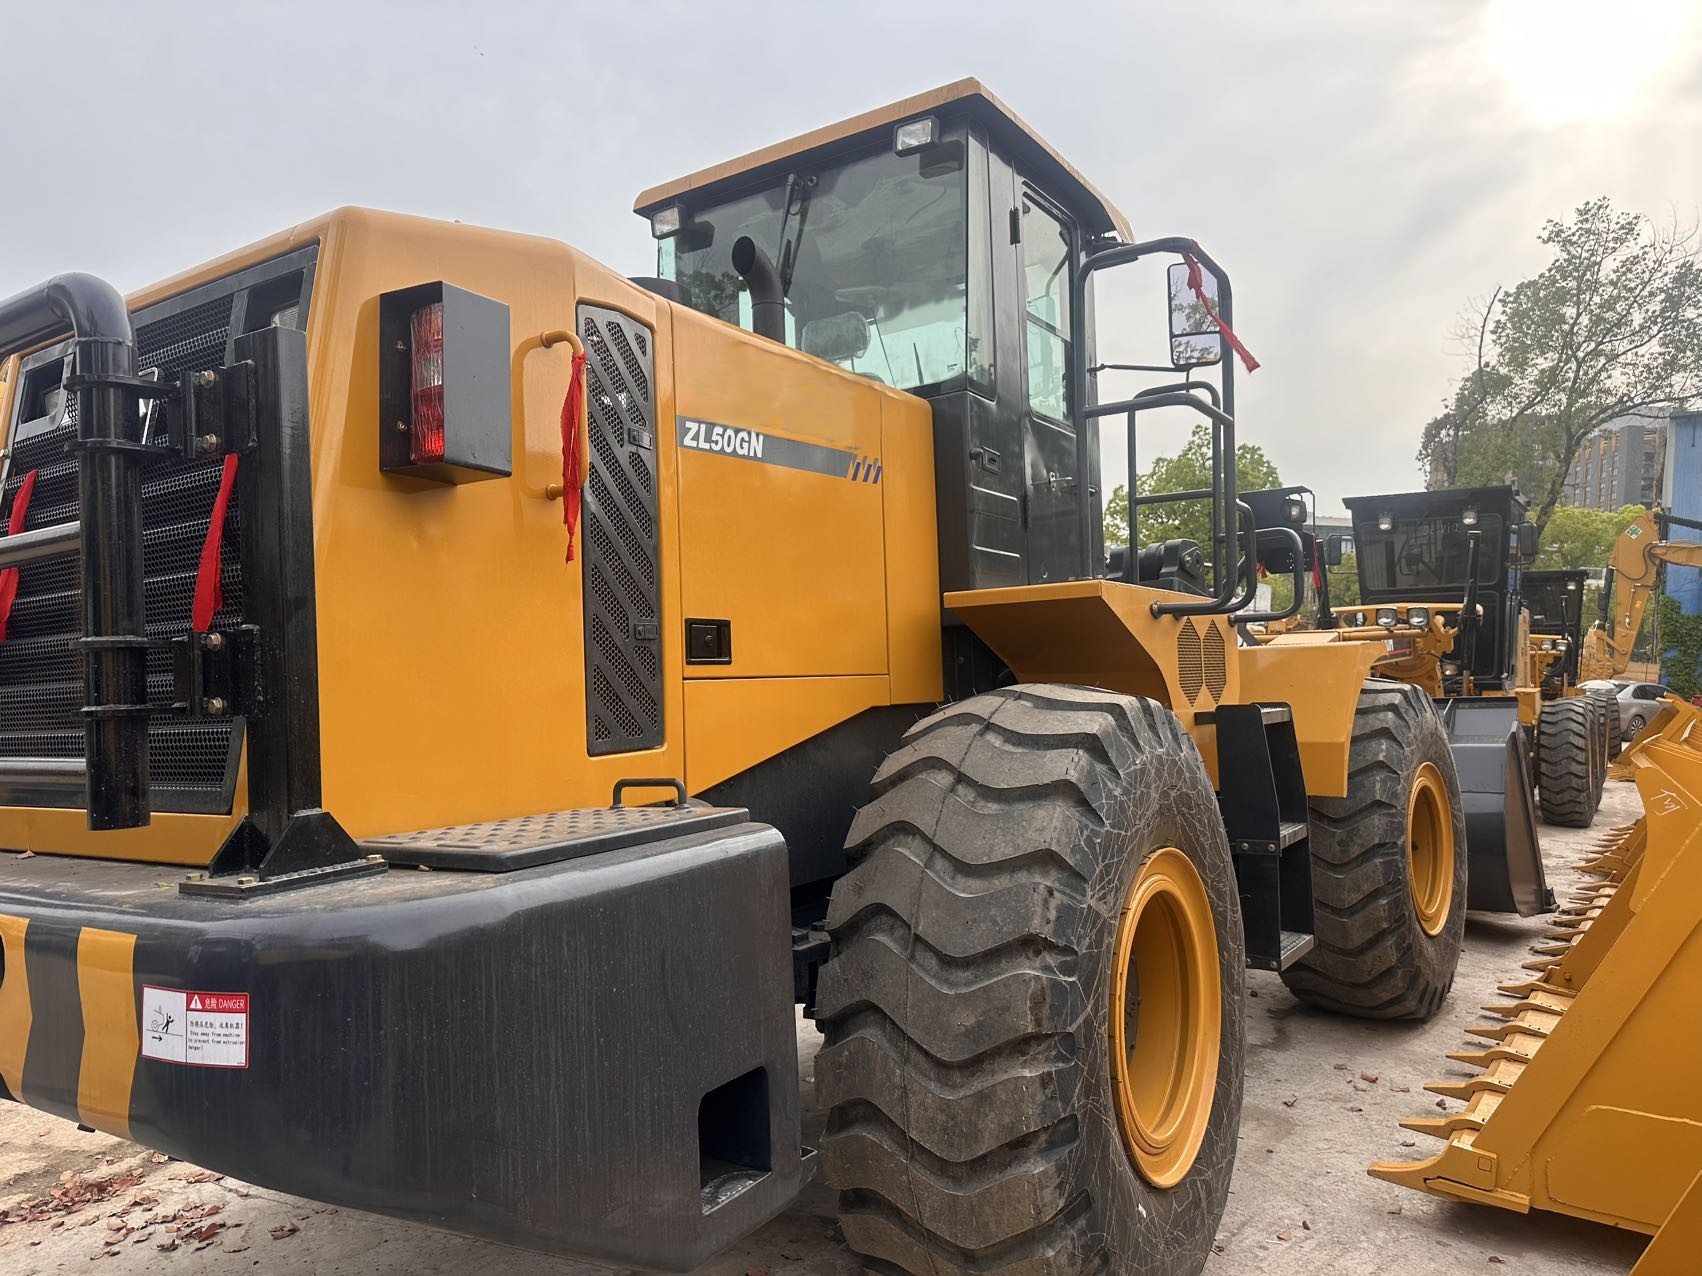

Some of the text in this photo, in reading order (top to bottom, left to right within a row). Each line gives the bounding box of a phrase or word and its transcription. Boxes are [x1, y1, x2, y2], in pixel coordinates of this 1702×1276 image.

[683, 420, 764, 459] ZL50GN
[204, 997, 245, 1009] 危险 DANGER
